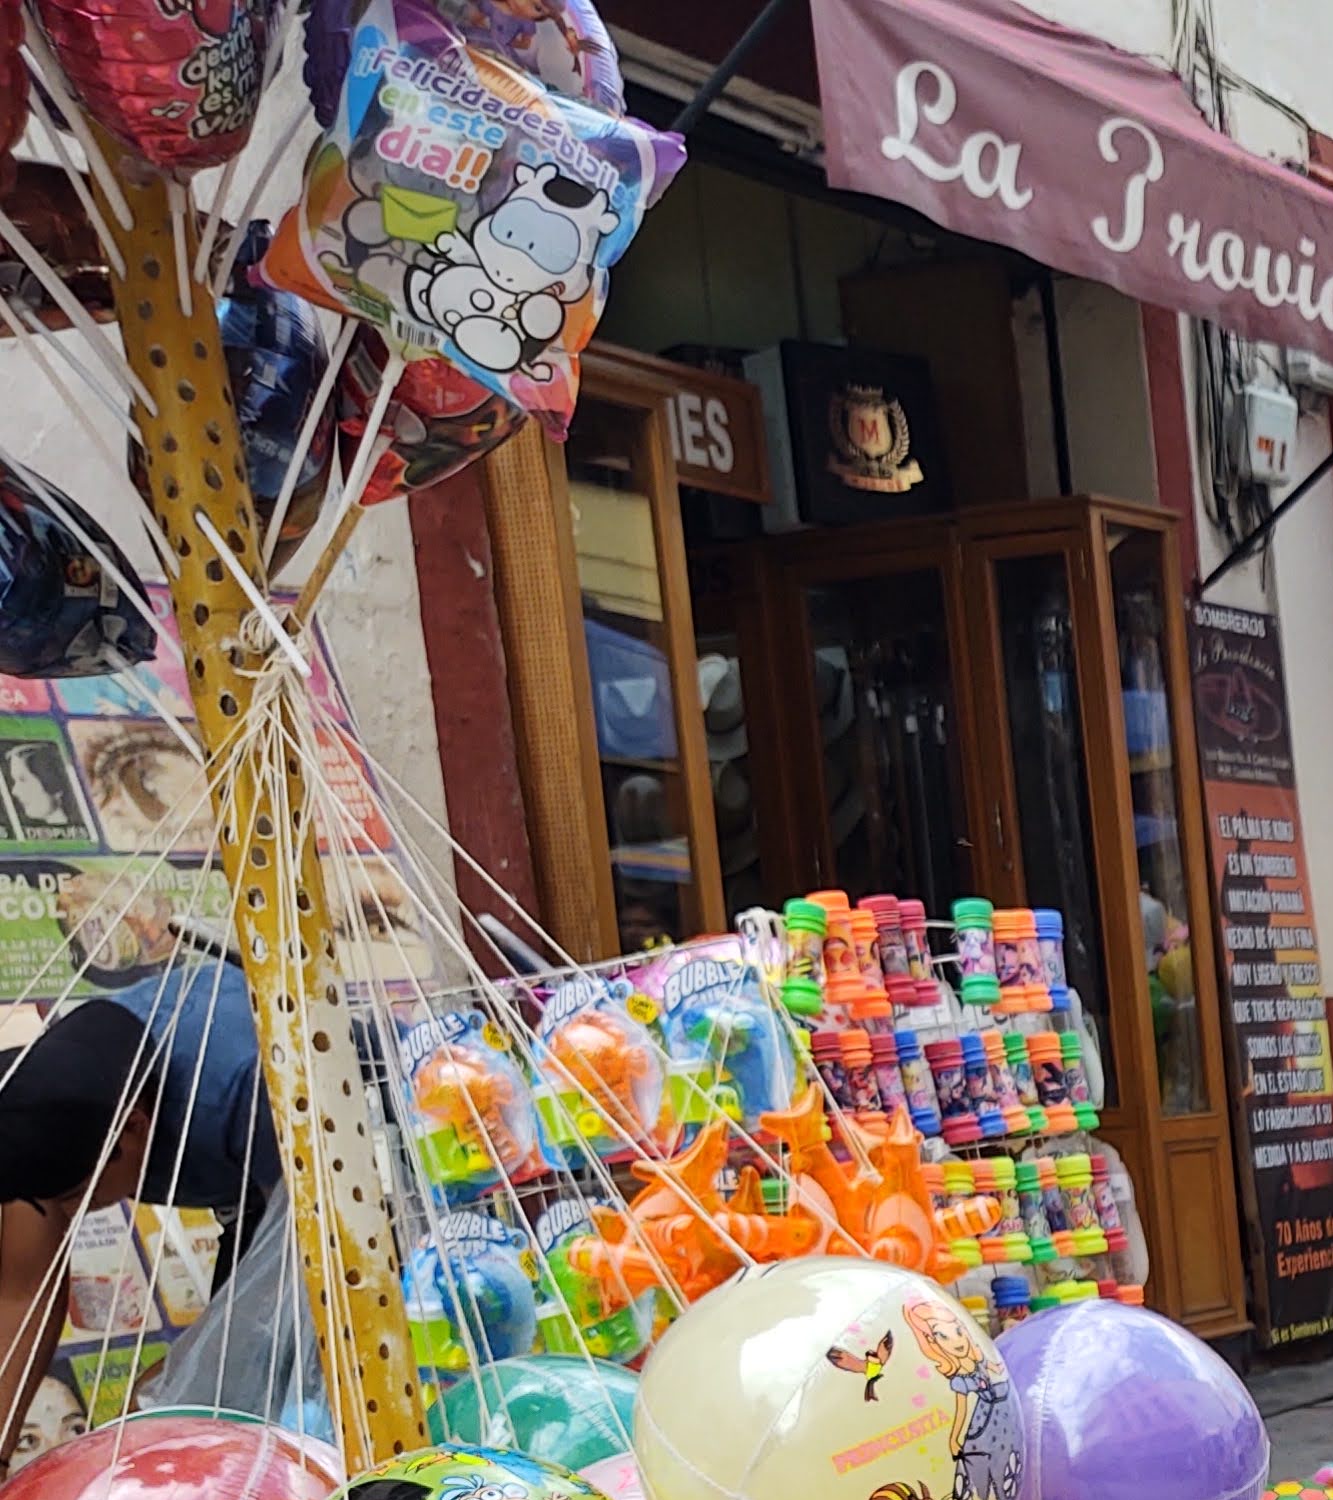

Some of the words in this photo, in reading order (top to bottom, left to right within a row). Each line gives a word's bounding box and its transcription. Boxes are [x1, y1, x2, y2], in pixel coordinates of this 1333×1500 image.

[380, 84, 421, 111] en
[428, 103, 507, 146] este
[880, 60, 1033, 212] La
[38, 872, 74, 895] DE
[401, 1012, 467, 1077] BUBLE
[1275, 1220, 1293, 1247] 70
[1295, 1217, 1324, 1244] Años
